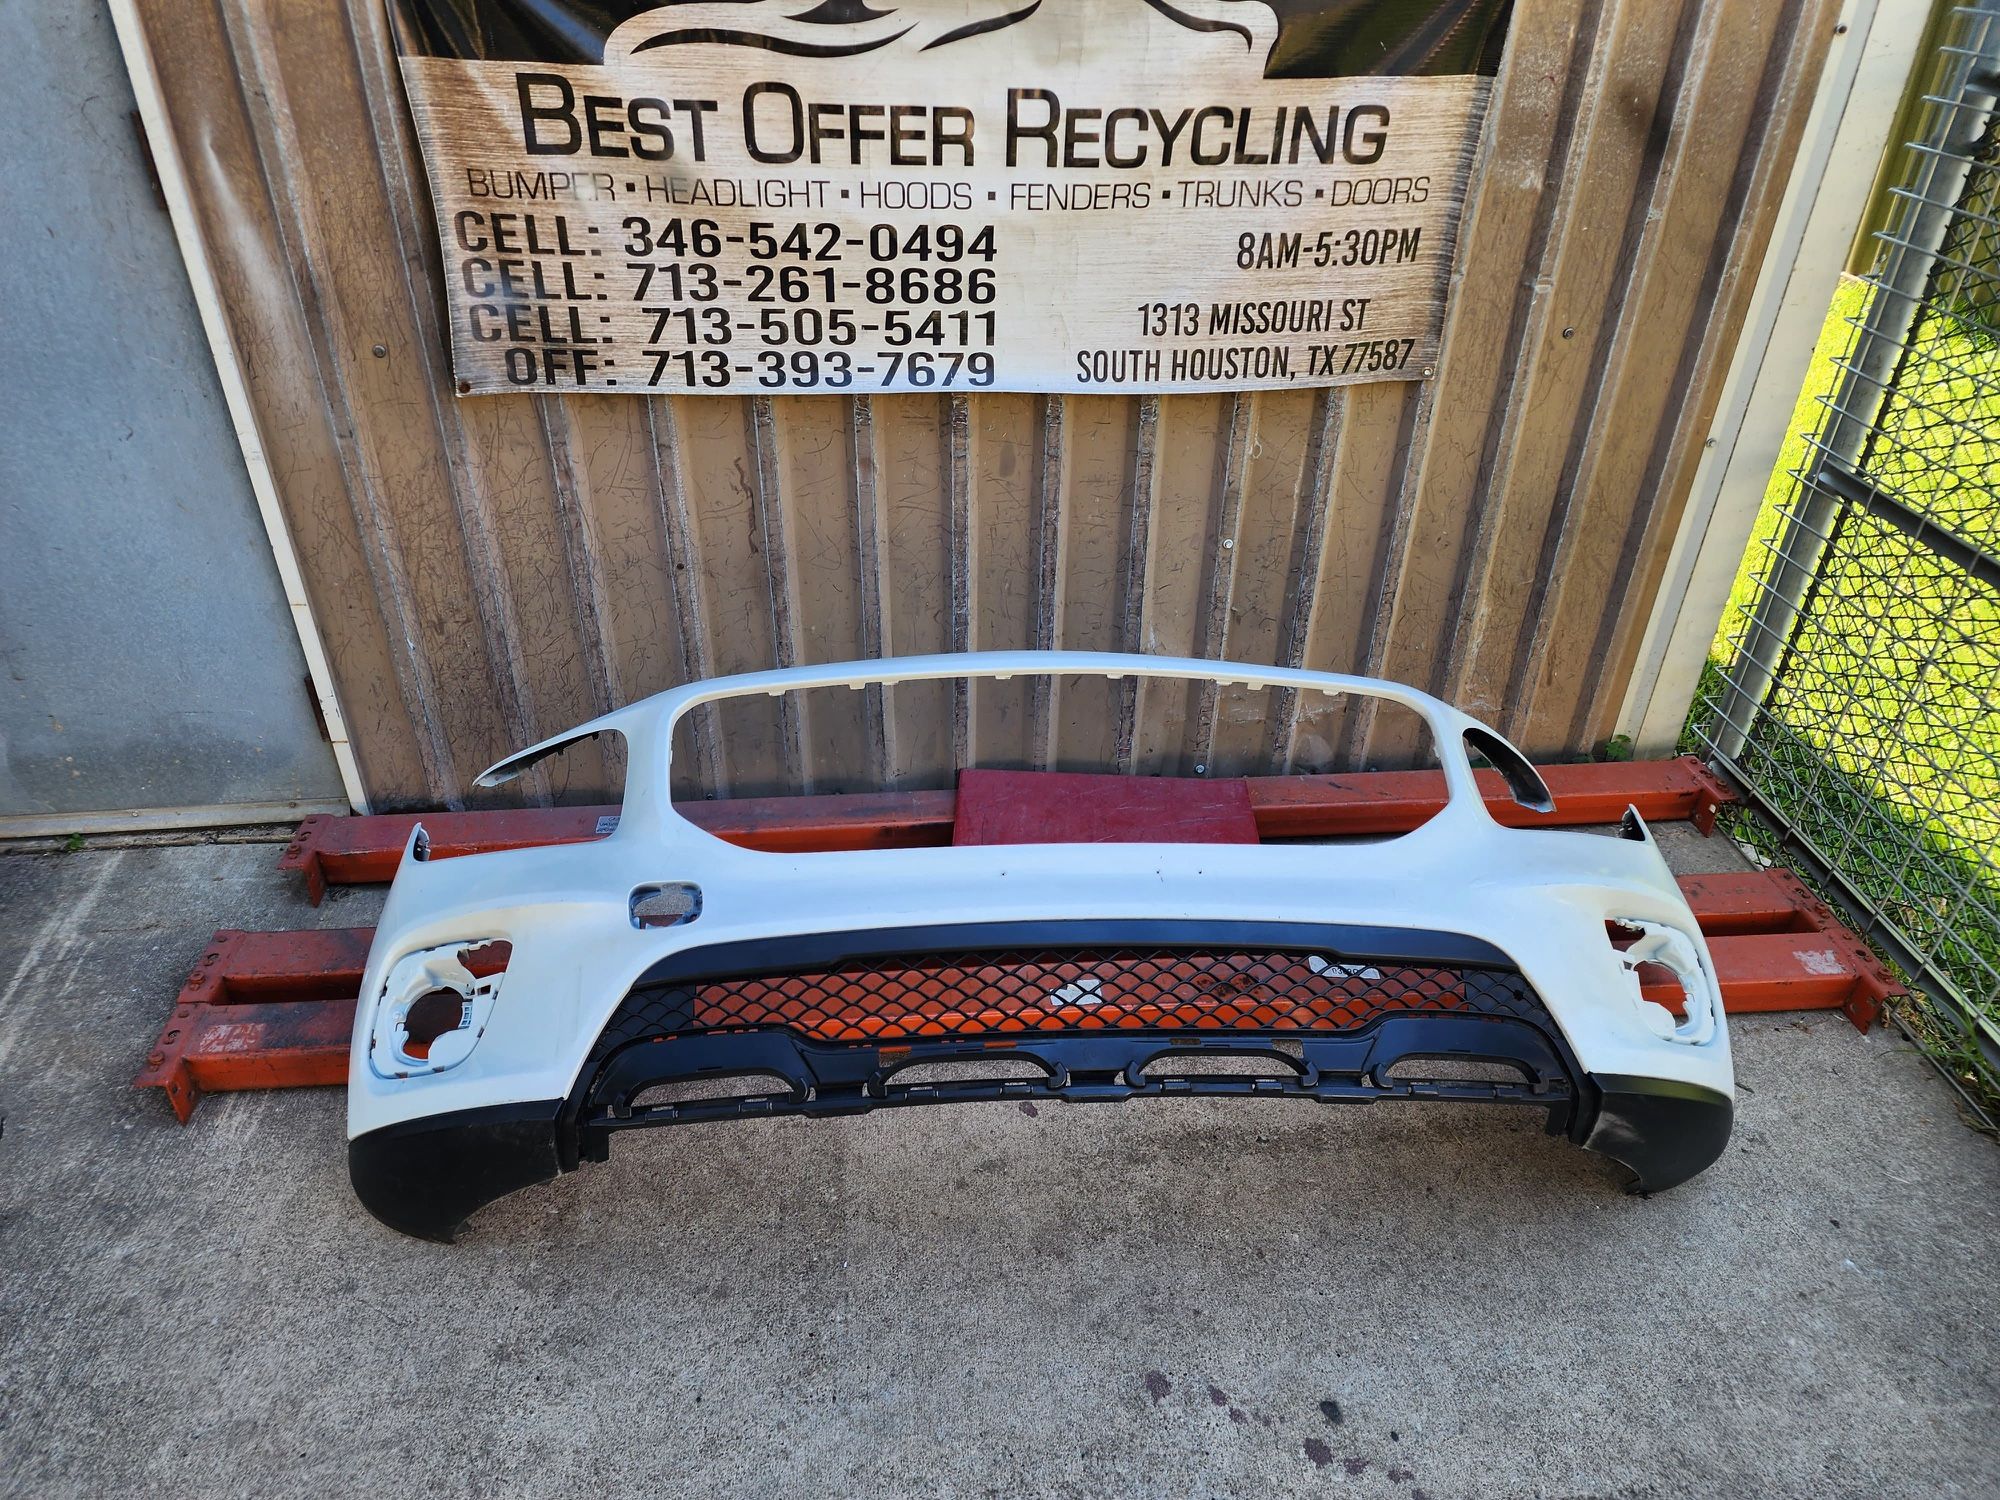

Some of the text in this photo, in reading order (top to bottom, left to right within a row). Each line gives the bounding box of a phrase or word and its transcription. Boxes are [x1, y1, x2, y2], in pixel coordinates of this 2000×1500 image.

[515, 72, 1391, 168] BEST OFFER RECYCLING
[645, 175, 830, 209] HEADLIGHT
[861, 181, 973, 210] HOODS
[1010, 183, 1151, 211] FENDERS
[1177, 180, 1303, 208] TRUNKS
[1330, 176, 1431, 207] DOORS
[454, 210, 998, 262] CELL: 346-542-0494
[1236, 227, 1422, 270] 8AM-5:30PM
[461, 257, 998, 304] CELL: 713-261-8686
[470, 303, 997, 347] CELL: 713-505-5411
[1137, 298, 1371, 337] 1313 MISSOURI ST
[504, 347, 996, 388] OFF: 713-393-7679
[1077, 338, 1416, 384] SOUTH HOUSTON, TX 77587
